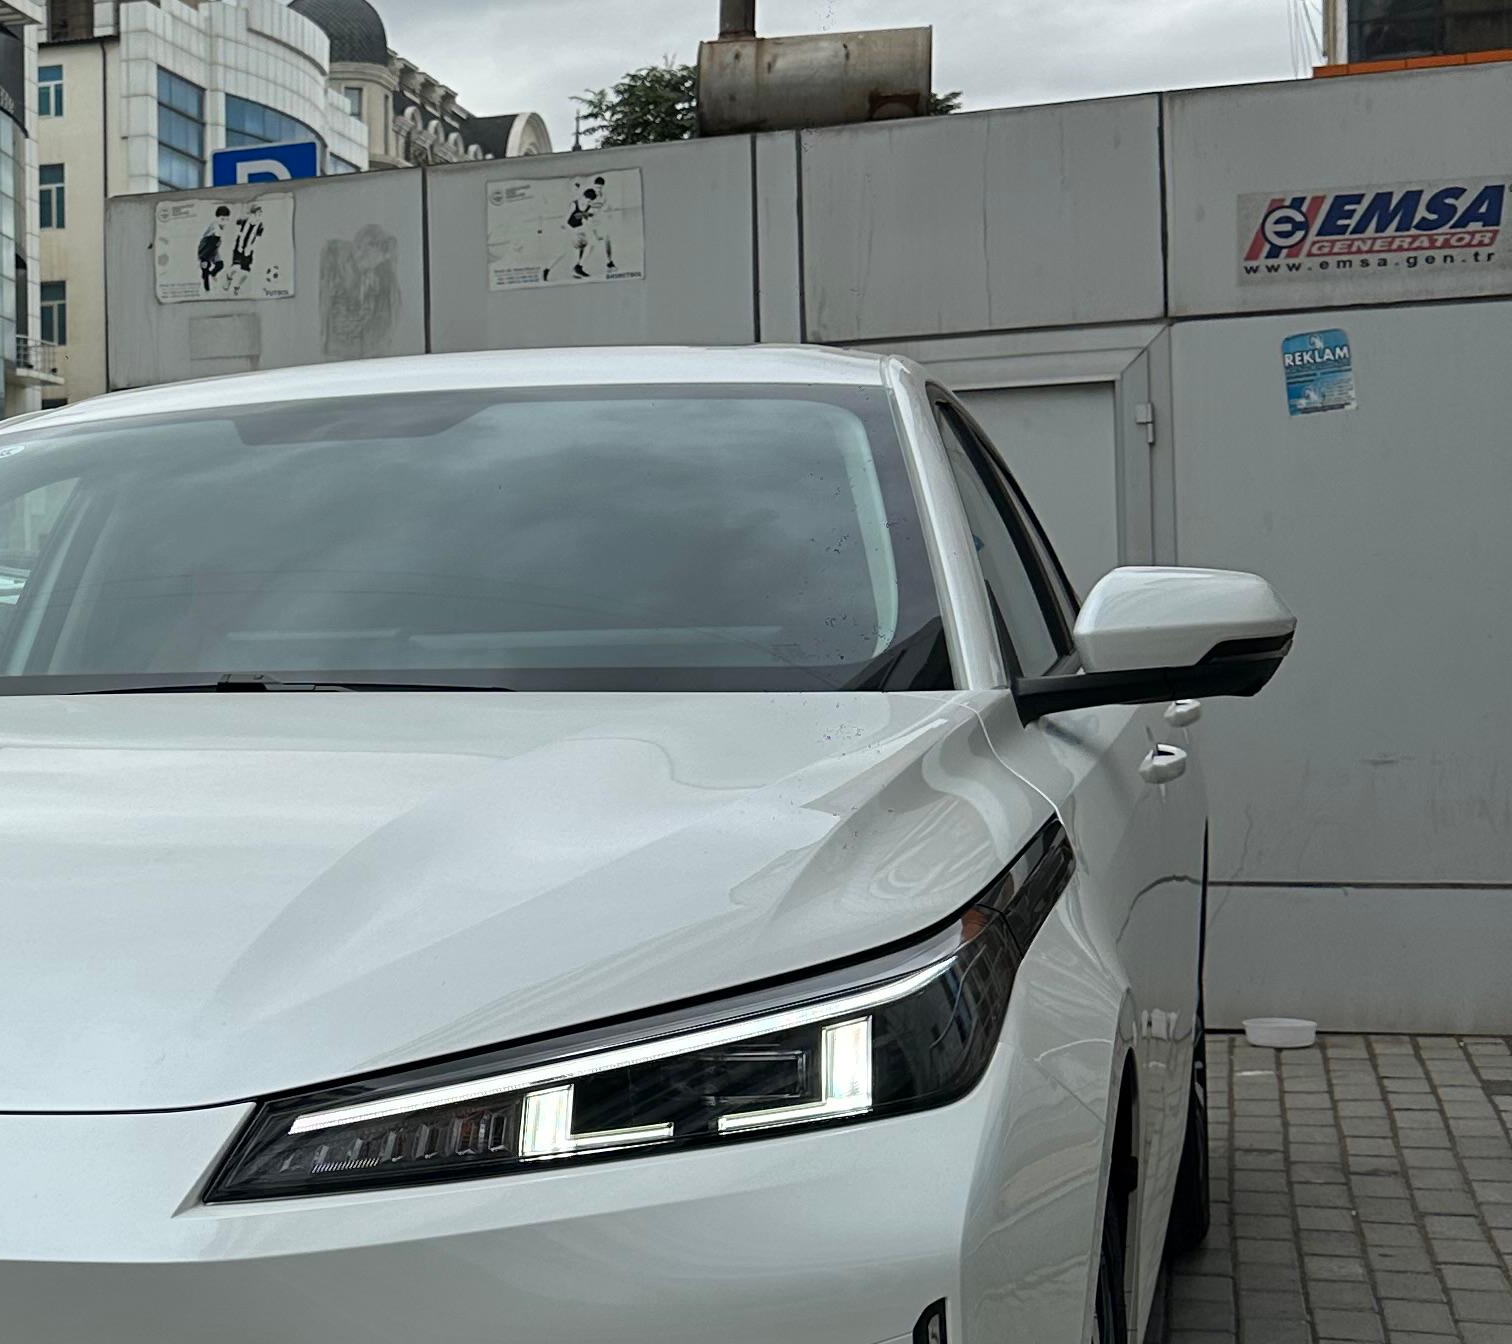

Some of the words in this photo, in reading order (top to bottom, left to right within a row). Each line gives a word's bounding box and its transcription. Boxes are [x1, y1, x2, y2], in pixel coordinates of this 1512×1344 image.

[1316, 184, 1505, 237] EMSA
[1310, 231, 1493, 256] GENERATOR
[1243, 249, 1495, 275] www.emsa.gen.tr
[1284, 345, 1349, 367] REKLAM
